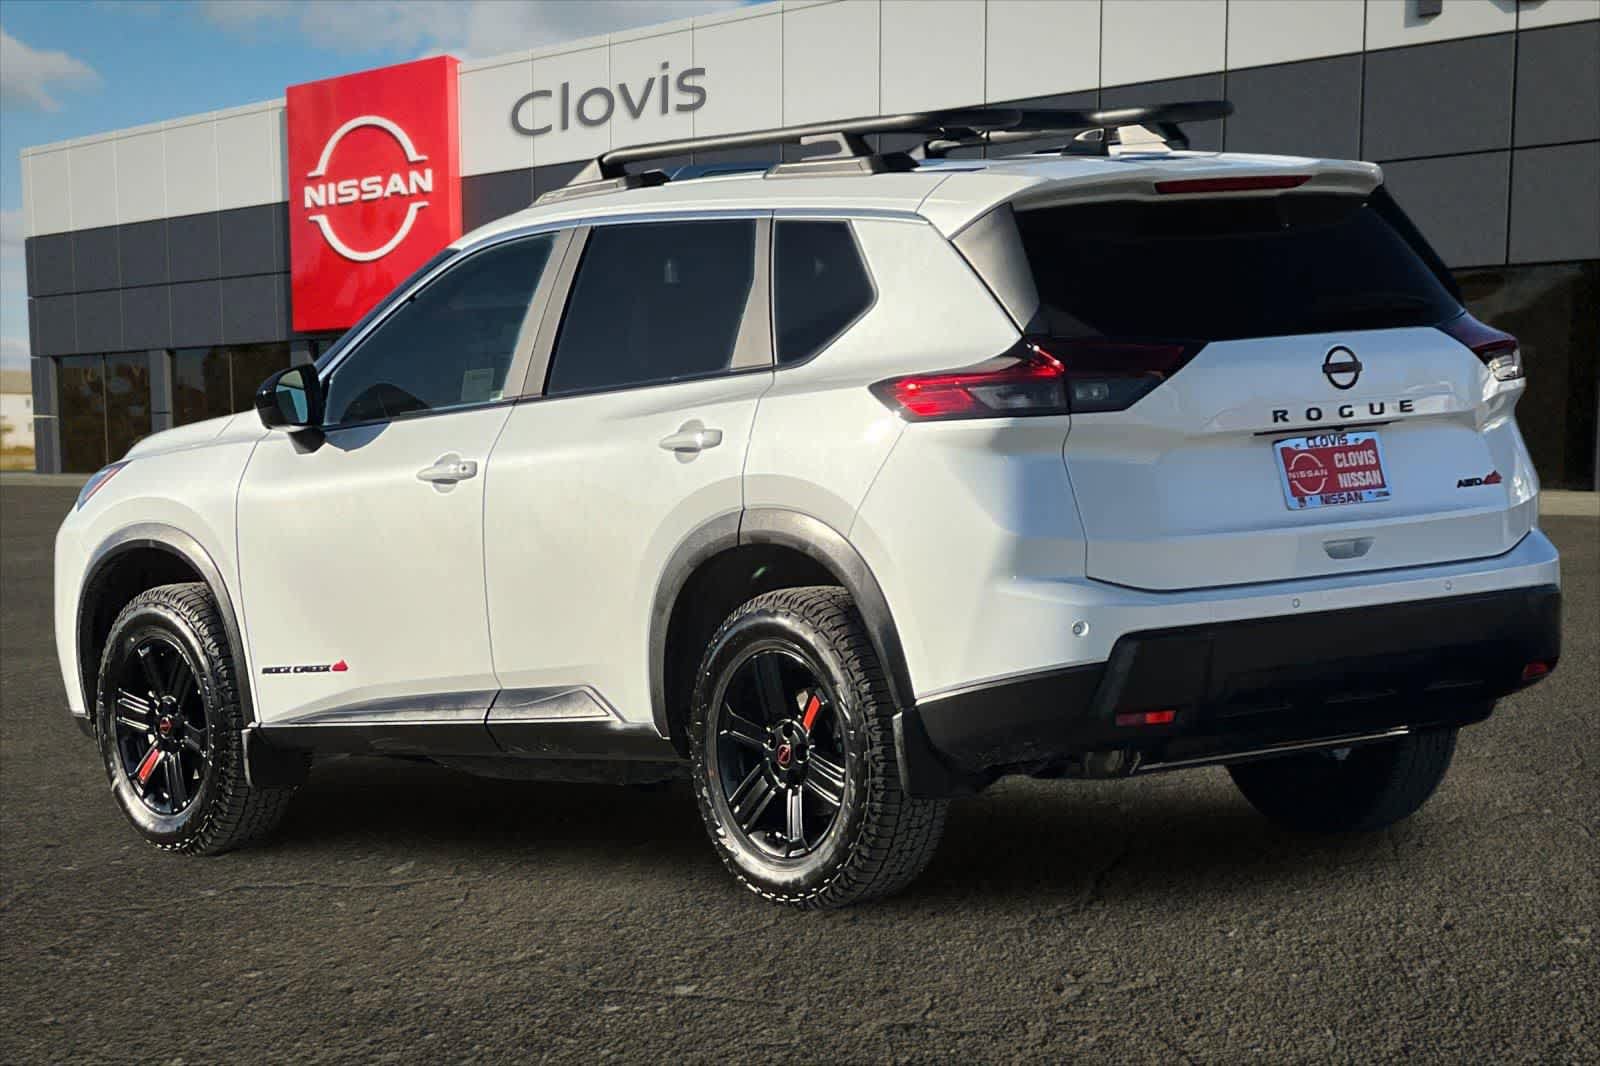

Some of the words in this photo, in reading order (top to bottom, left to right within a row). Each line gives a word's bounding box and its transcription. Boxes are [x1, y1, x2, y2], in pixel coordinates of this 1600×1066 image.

[511, 61, 707, 136] Clovis
[304, 168, 433, 209] NISSAN
[1272, 399, 1415, 424] ROGUE
[1306, 433, 1349, 448] CLOVIS
[1333, 449, 1377, 468] CLOVIS
[1288, 468, 1328, 479] NISSAN
[1338, 470, 1382, 488] NISSAN
[1320, 491, 1363, 505] NISSAN
